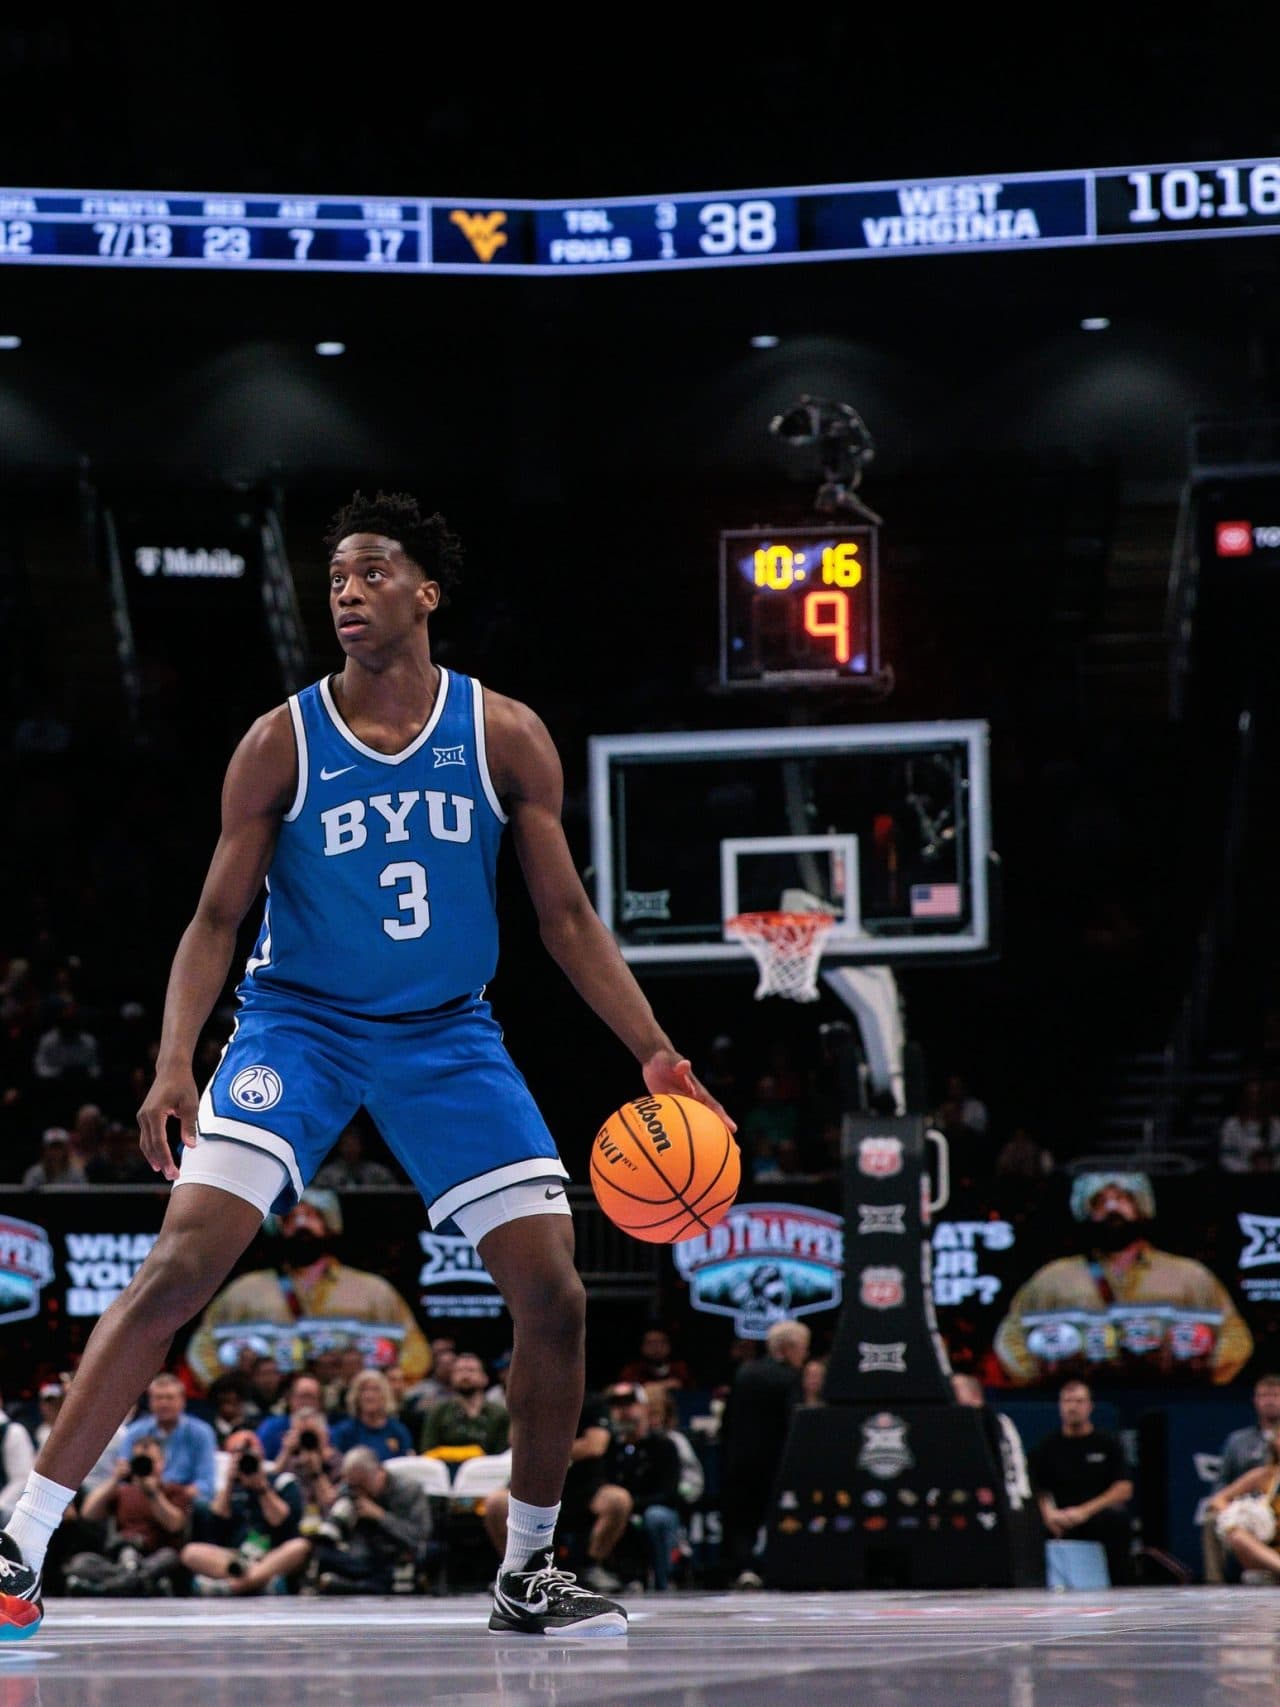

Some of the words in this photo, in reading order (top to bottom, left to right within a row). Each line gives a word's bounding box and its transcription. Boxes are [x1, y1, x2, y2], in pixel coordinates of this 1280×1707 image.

[897, 182, 1004, 216] WEST
[1129, 164, 1280, 223] 10:16
[92, 222, 173, 260] 7/13
[202, 226, 251, 262] 23
[288, 228, 315, 262] 7
[365, 228, 405, 264] 17
[550, 237, 632, 263] FOULS
[699, 200, 777, 255] 38
[862, 208, 1040, 248] VIRGINIA
[754, 543, 862, 590] 10:16
[804, 591, 850, 664] 9
[321, 790, 474, 856] BYU
[379, 861, 431, 941] 3
[64, 1233, 161, 1261] WHA
